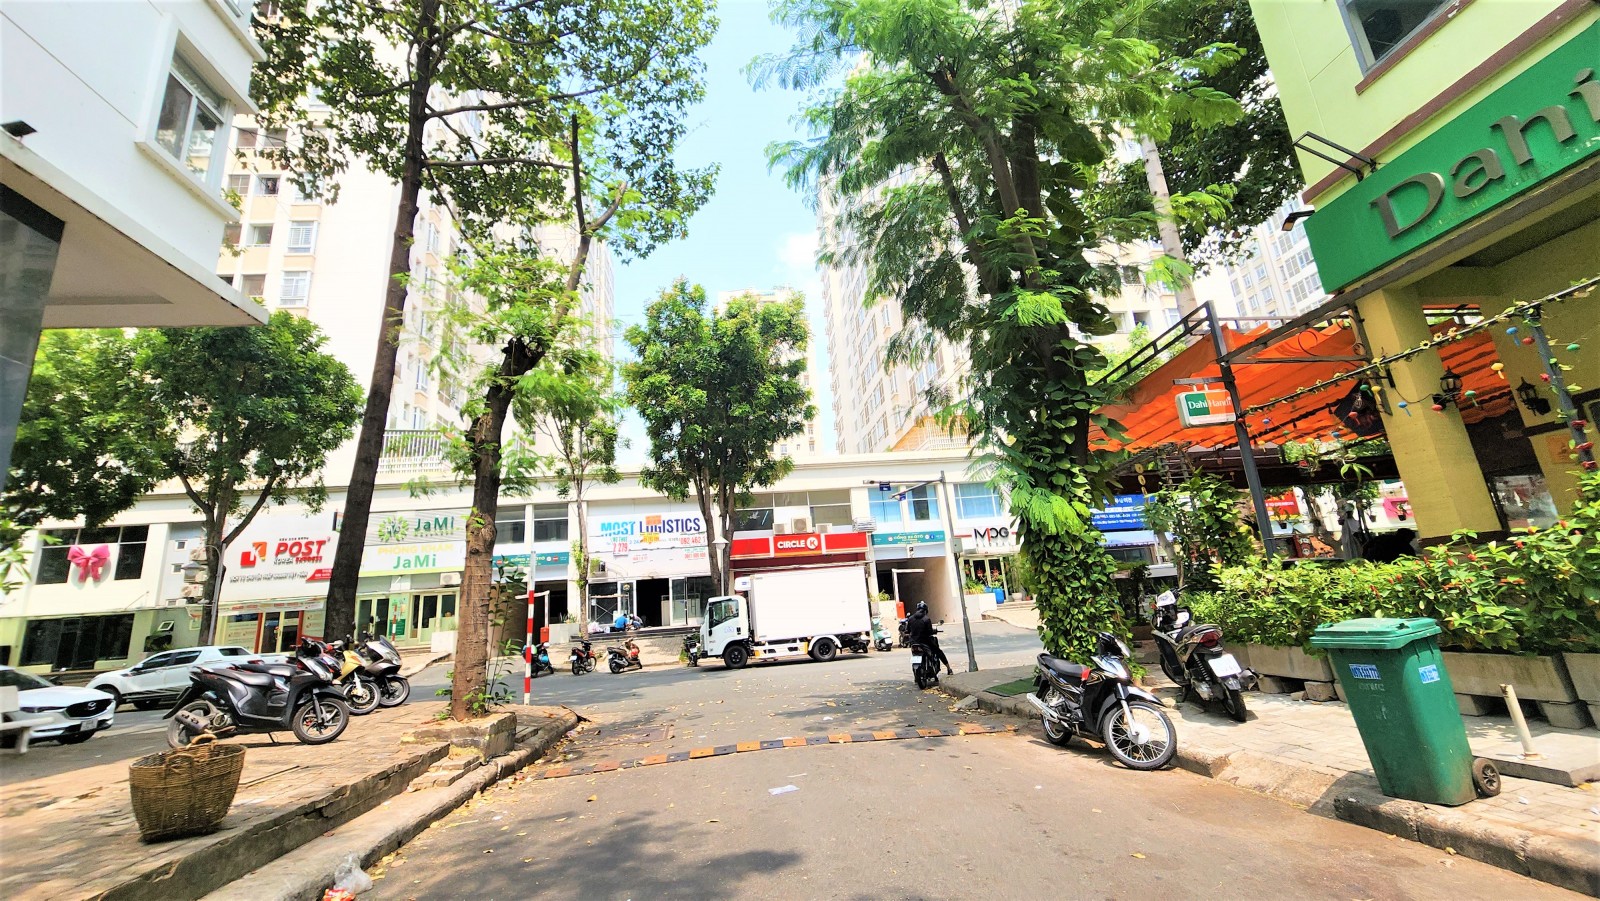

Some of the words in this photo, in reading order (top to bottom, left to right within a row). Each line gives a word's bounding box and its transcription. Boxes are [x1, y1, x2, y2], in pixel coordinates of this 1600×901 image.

[1187, 399, 1208, 410] Dahi
[414, 516, 455, 531] JaMi
[600, 521, 635, 536] MOST
[275, 540, 326, 557] POST
[777, 540, 806, 549] CIRCLE
[393, 554, 437, 569] JaMi
